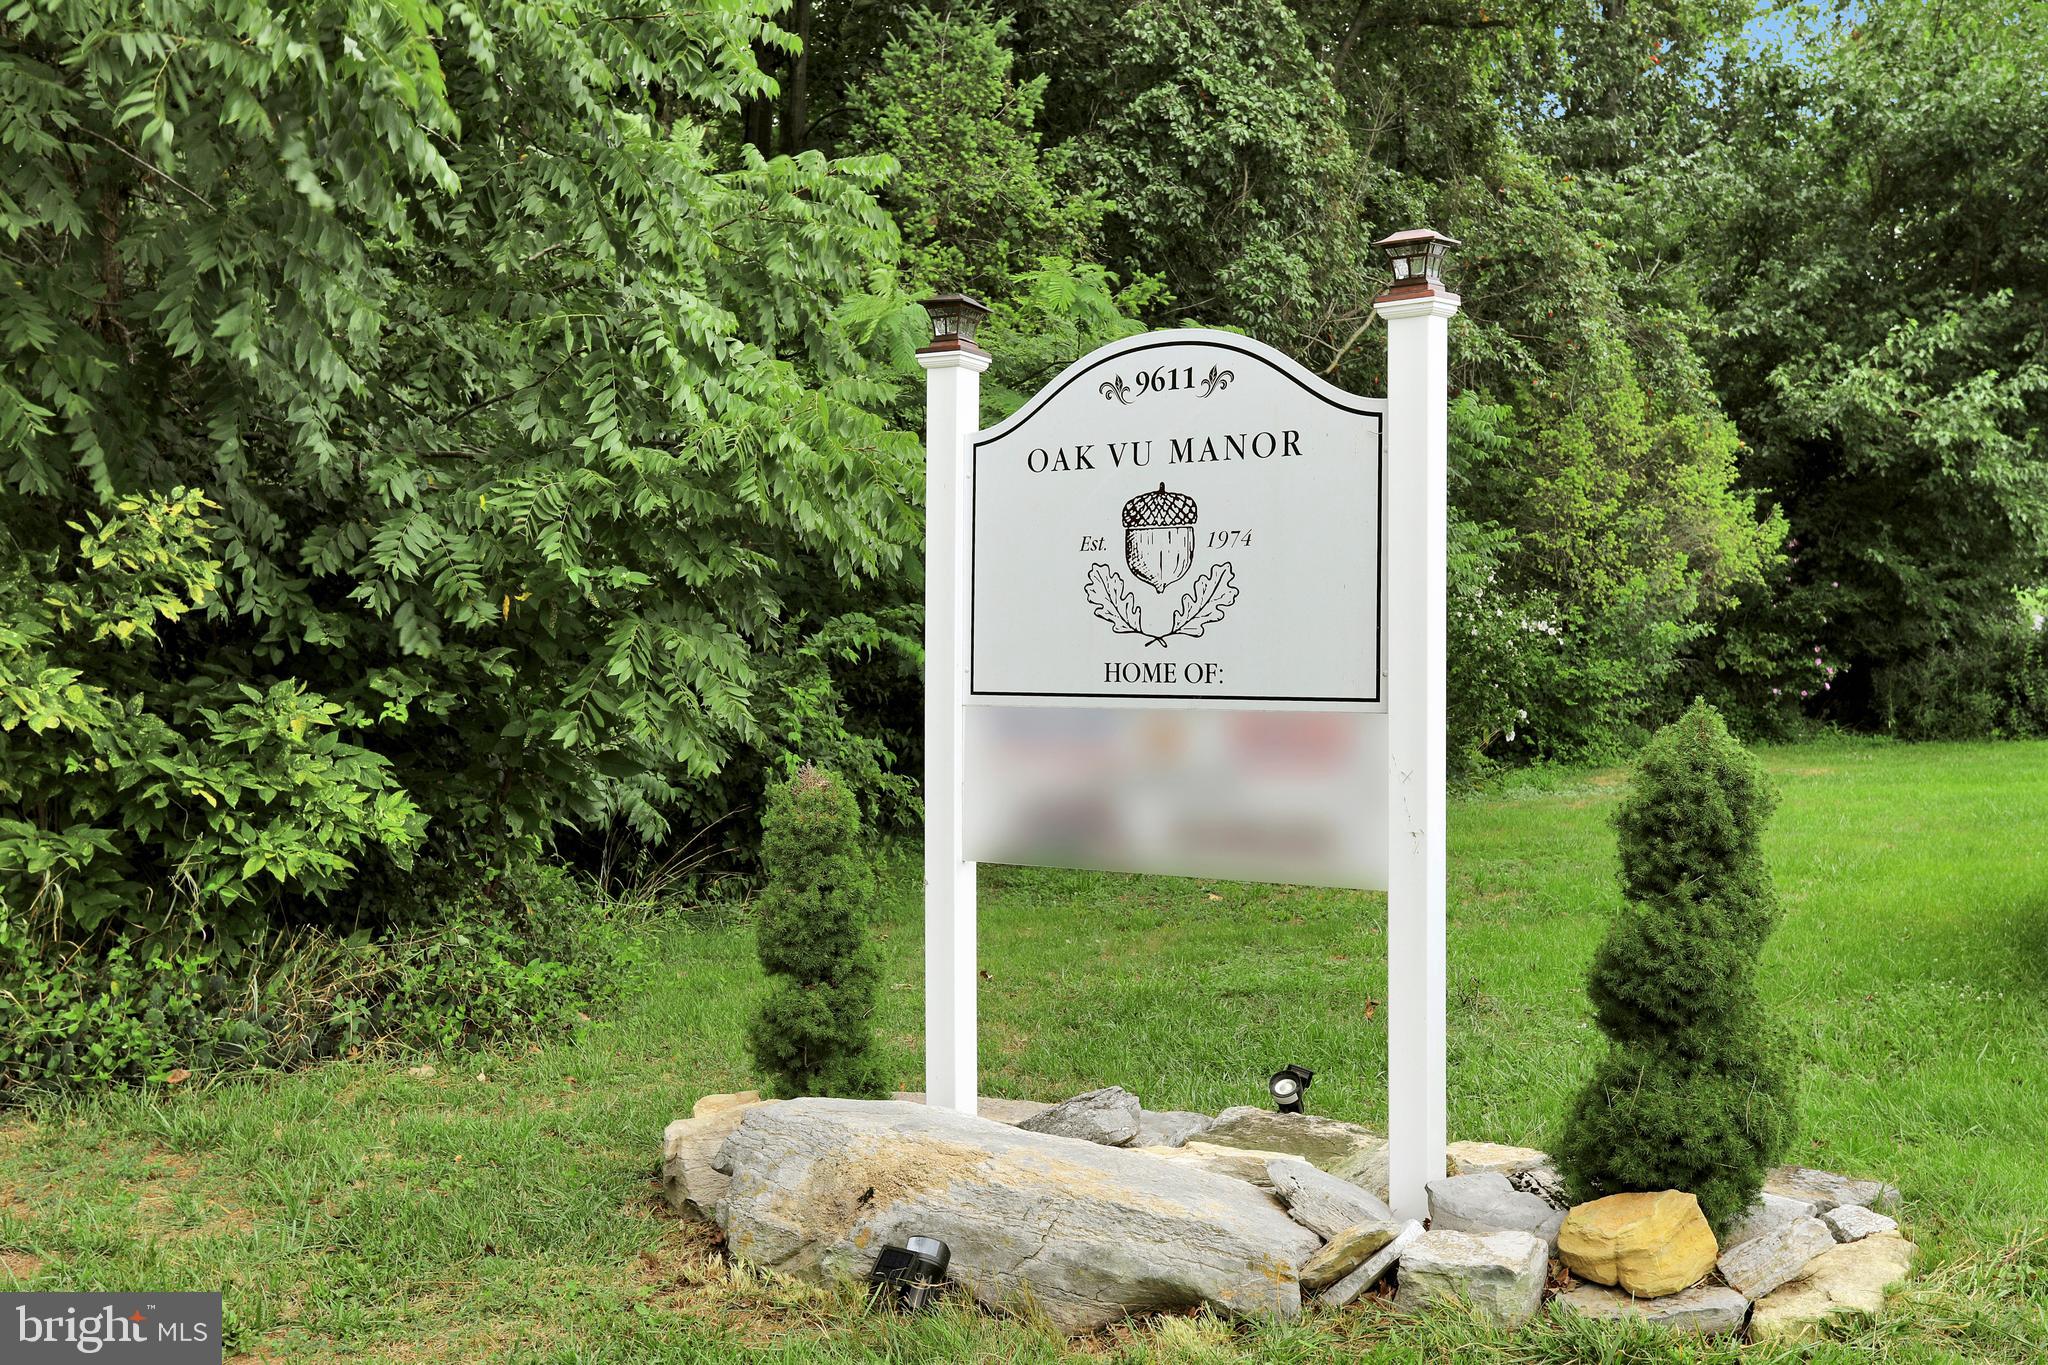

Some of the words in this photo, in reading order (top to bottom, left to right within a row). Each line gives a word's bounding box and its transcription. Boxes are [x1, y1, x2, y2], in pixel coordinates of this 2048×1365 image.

[1136, 366, 1196, 398] 9611
[1027, 444, 1096, 474] OAK
[1106, 440, 1153, 468] VU
[1168, 429, 1304, 465] MANOR
[1079, 535, 1108, 552] Est.
[1207, 528, 1253, 550] 1974
[1103, 662, 1177, 684] HOME
[1184, 662, 1224, 685] OF:
